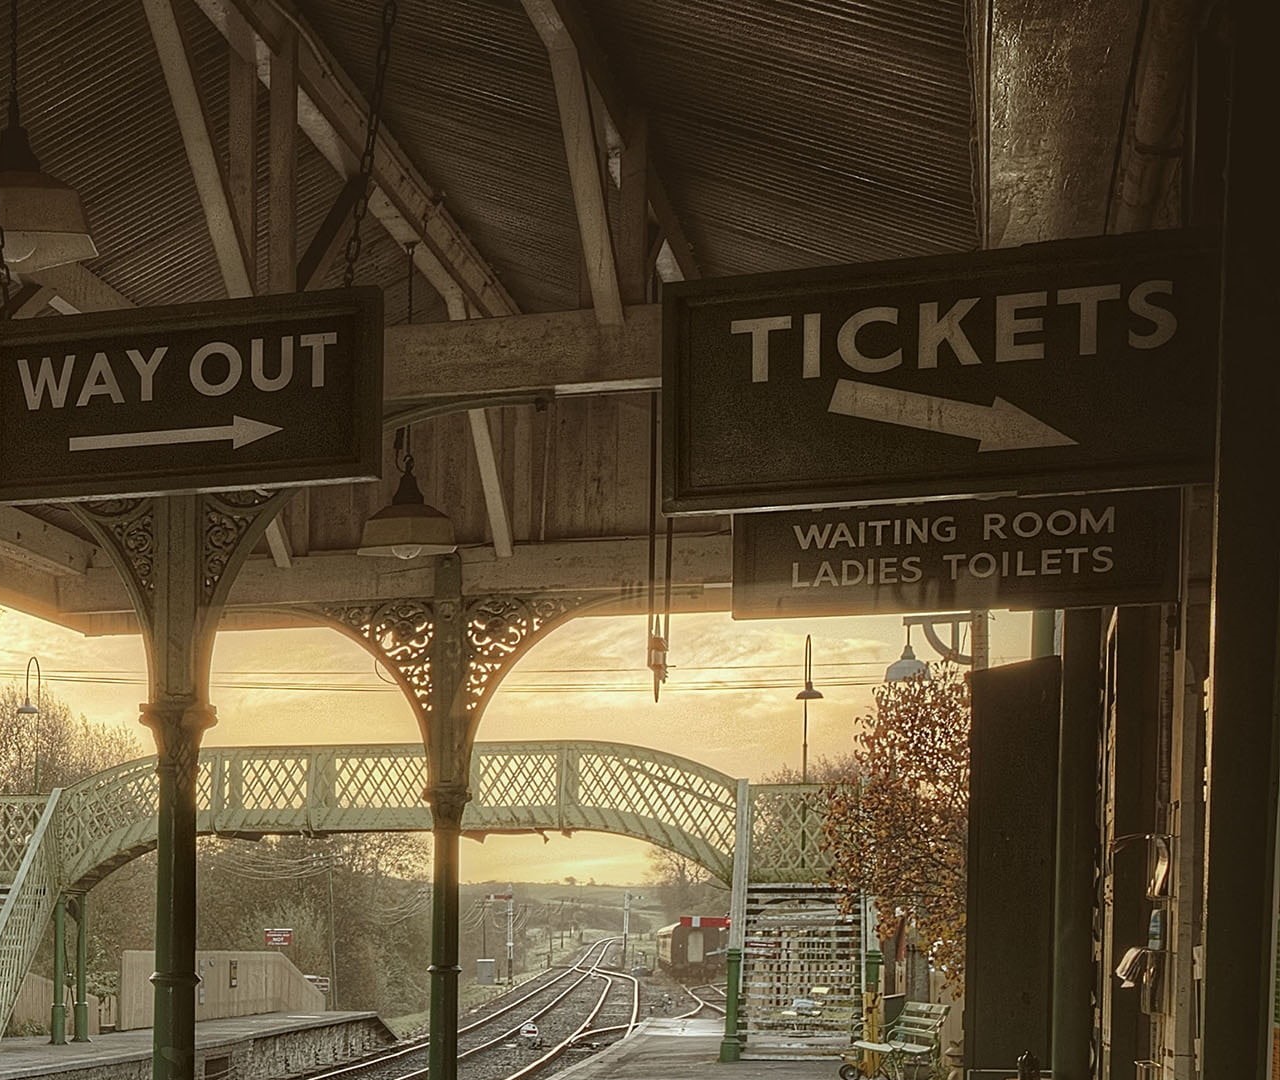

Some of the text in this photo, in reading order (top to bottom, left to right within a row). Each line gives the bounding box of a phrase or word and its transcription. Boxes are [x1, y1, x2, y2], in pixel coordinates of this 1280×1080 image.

[730, 280, 1178, 383] TICKETS
[17, 331, 338, 411] WAY OUT
[793, 506, 1116, 551] WAITING ROOM
[791, 546, 1115, 589] LADIES TOILETS
